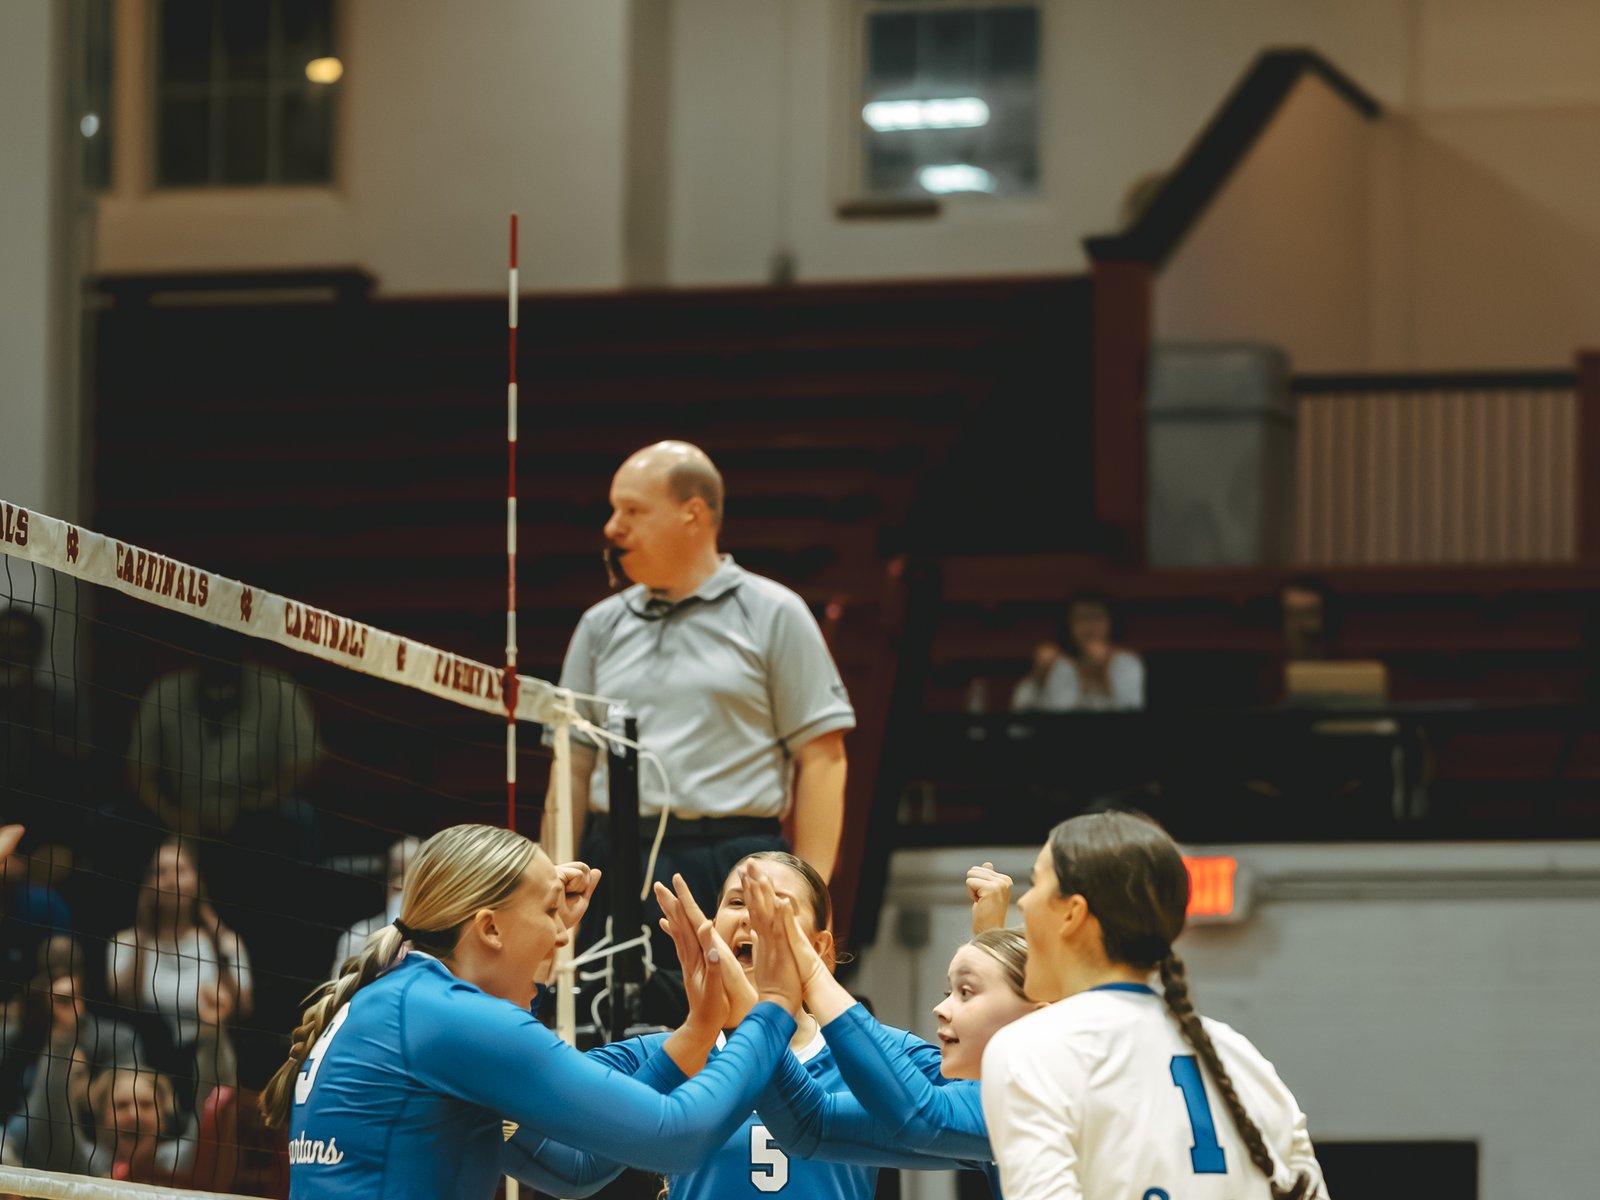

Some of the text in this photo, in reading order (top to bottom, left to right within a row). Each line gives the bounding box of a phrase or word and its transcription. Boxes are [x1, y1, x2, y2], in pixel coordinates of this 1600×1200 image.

[115, 542, 209, 607] CARDINALS
[1169, 1055, 1229, 1175] 1
[749, 1124, 790, 1194] 5
